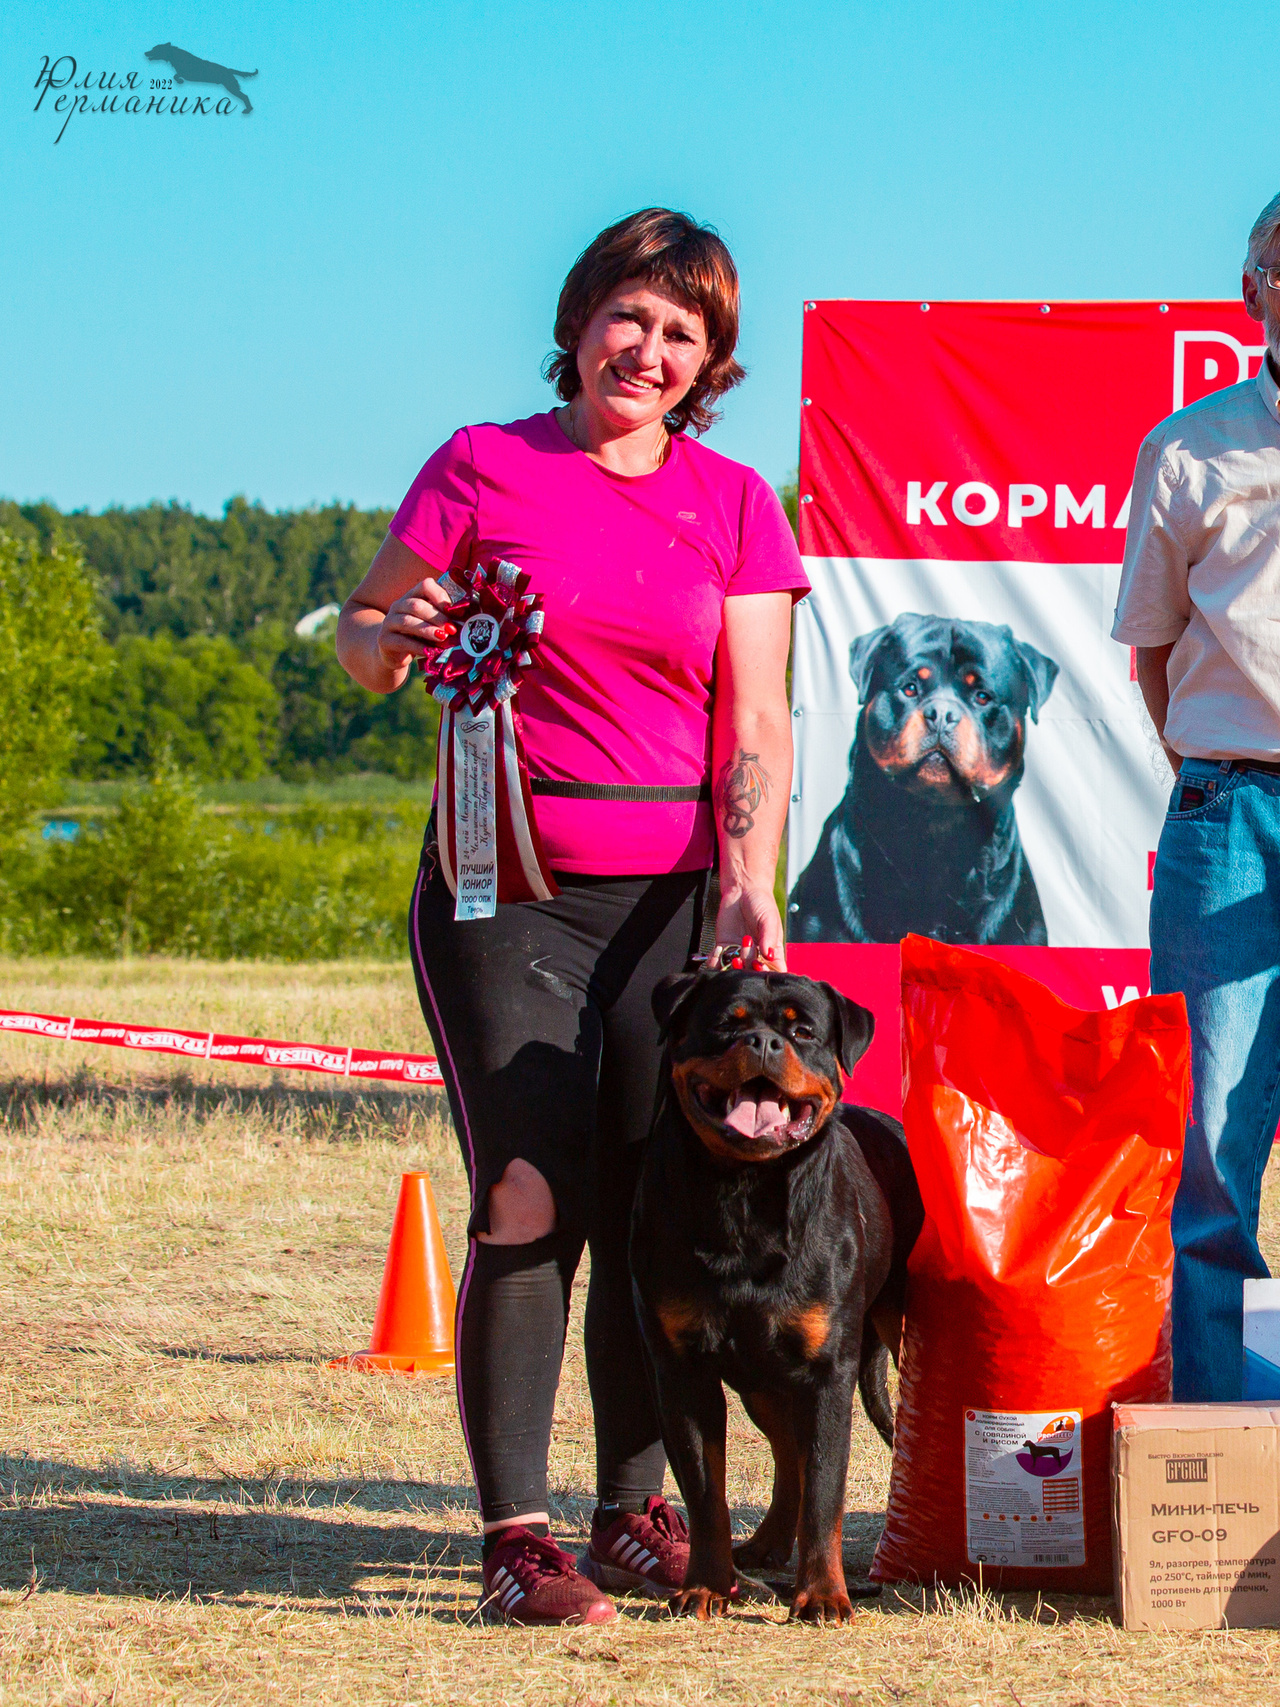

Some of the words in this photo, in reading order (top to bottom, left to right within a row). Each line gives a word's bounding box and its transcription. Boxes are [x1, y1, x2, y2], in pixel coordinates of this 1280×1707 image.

[460, 861, 494, 875] ЛУЧШИЙ
[462, 879, 492, 890] ЮНИОР
[0, 1016, 69, 1036] ТРАПЕЗ
[128, 1032, 207, 1054] ТРАПЕЗА
[268, 1048, 345, 1070] ТРАПЕЗА
[982, 1431, 1027, 1439] ГОВЯДИНОЙ
[1166, 1460, 1207, 1481] GFGRIL
[1151, 1528, 1228, 1544] GFO-09
[1149, 1560, 1164, 1569] 9л,
[1166, 1559, 1212, 1570] разогрев,
[1214, 1557, 1276, 1569] температура
[1149, 1574, 1162, 1583] до
[1196, 1571, 1232, 1582] таймер
[1233, 1571, 1245, 1579] 60
[1247, 1571, 1271, 1580] мин,
[1150, 1586, 1201, 1597] противень
[1203, 1585, 1222, 1595] для
[1223, 1584, 1269, 1594] выпечки,
[1151, 1600, 1174, 1609] 1000
[1175, 1599, 1187, 1608] Вт
